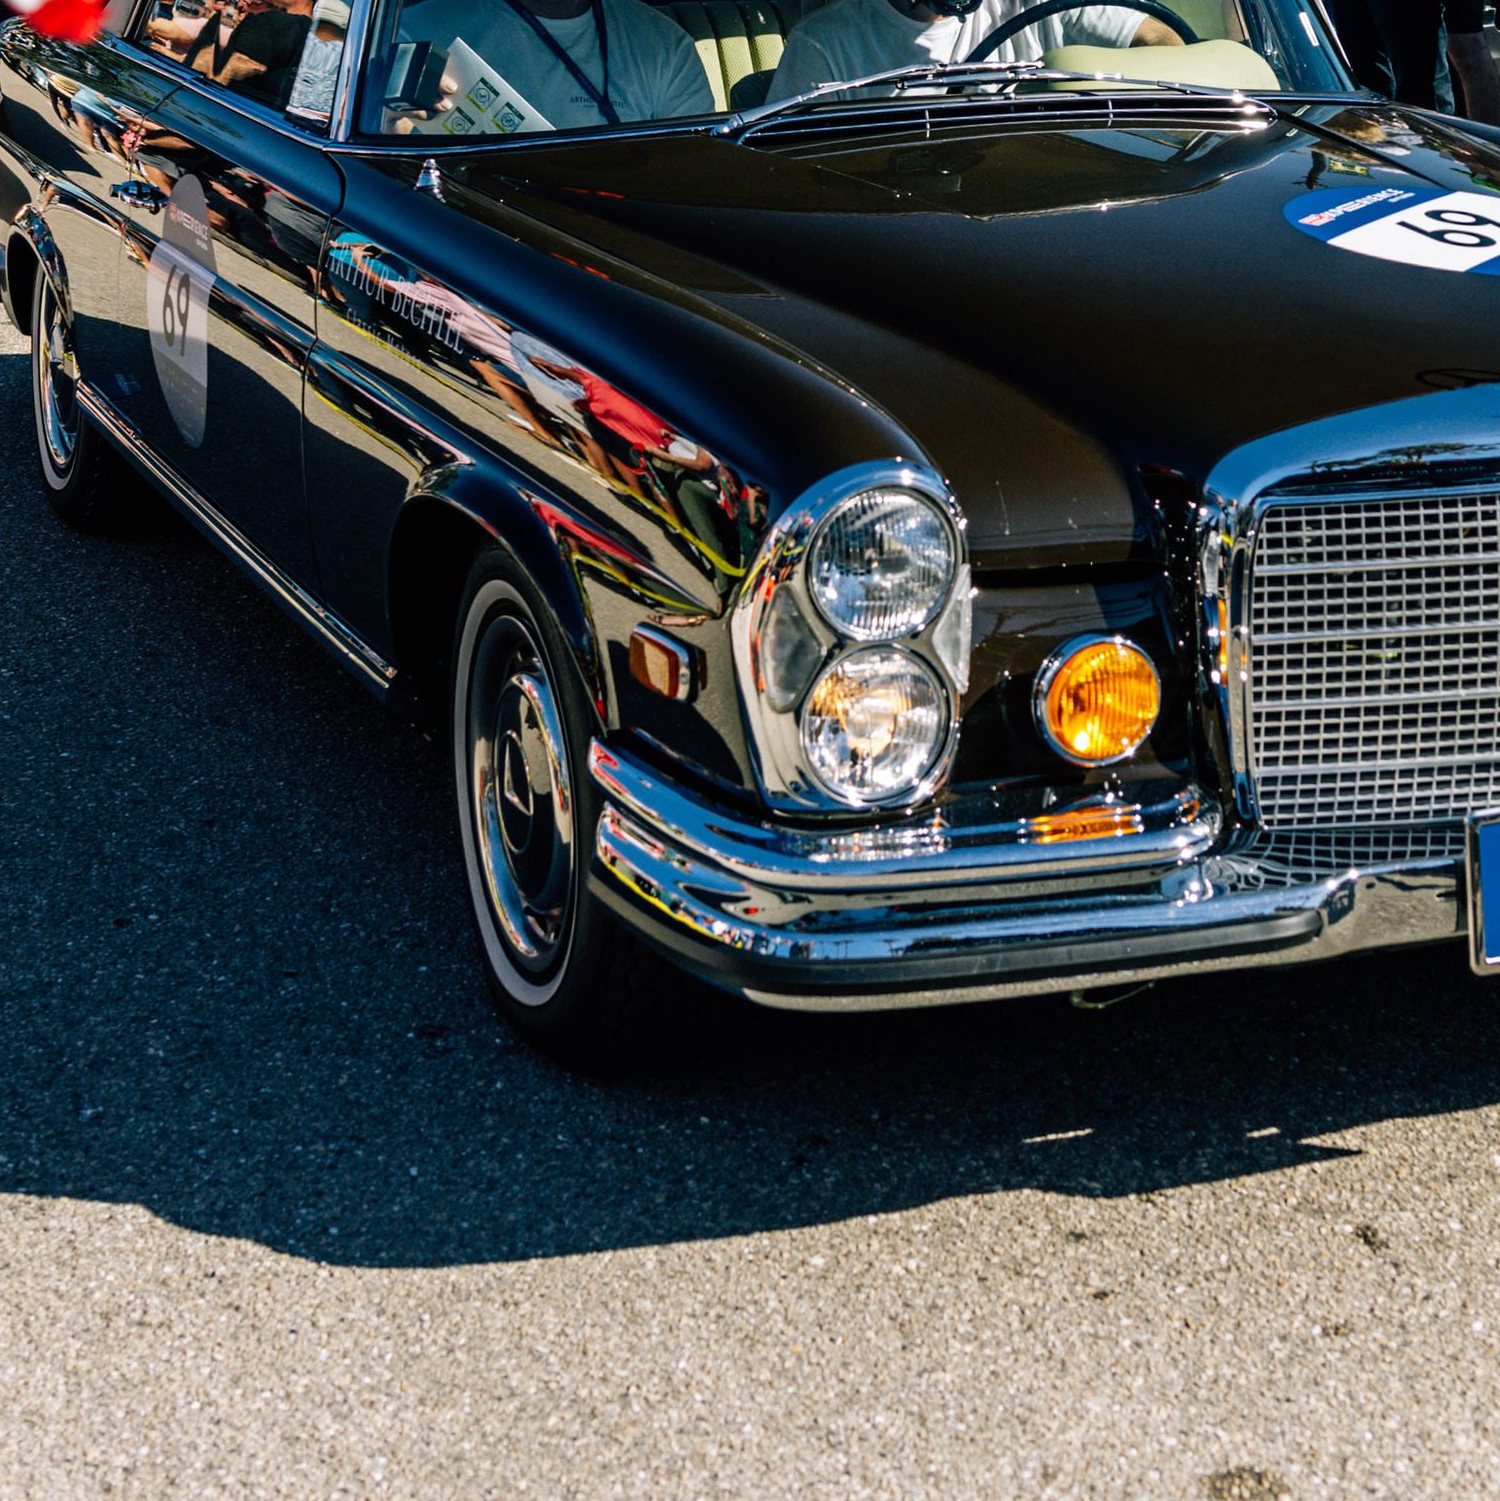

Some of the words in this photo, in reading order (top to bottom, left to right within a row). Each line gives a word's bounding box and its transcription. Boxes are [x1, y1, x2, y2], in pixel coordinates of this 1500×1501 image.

[163, 264, 191, 357] 69
[325, 242, 389, 305] ARTHUR
[391, 276, 463, 355] BECHTEL
